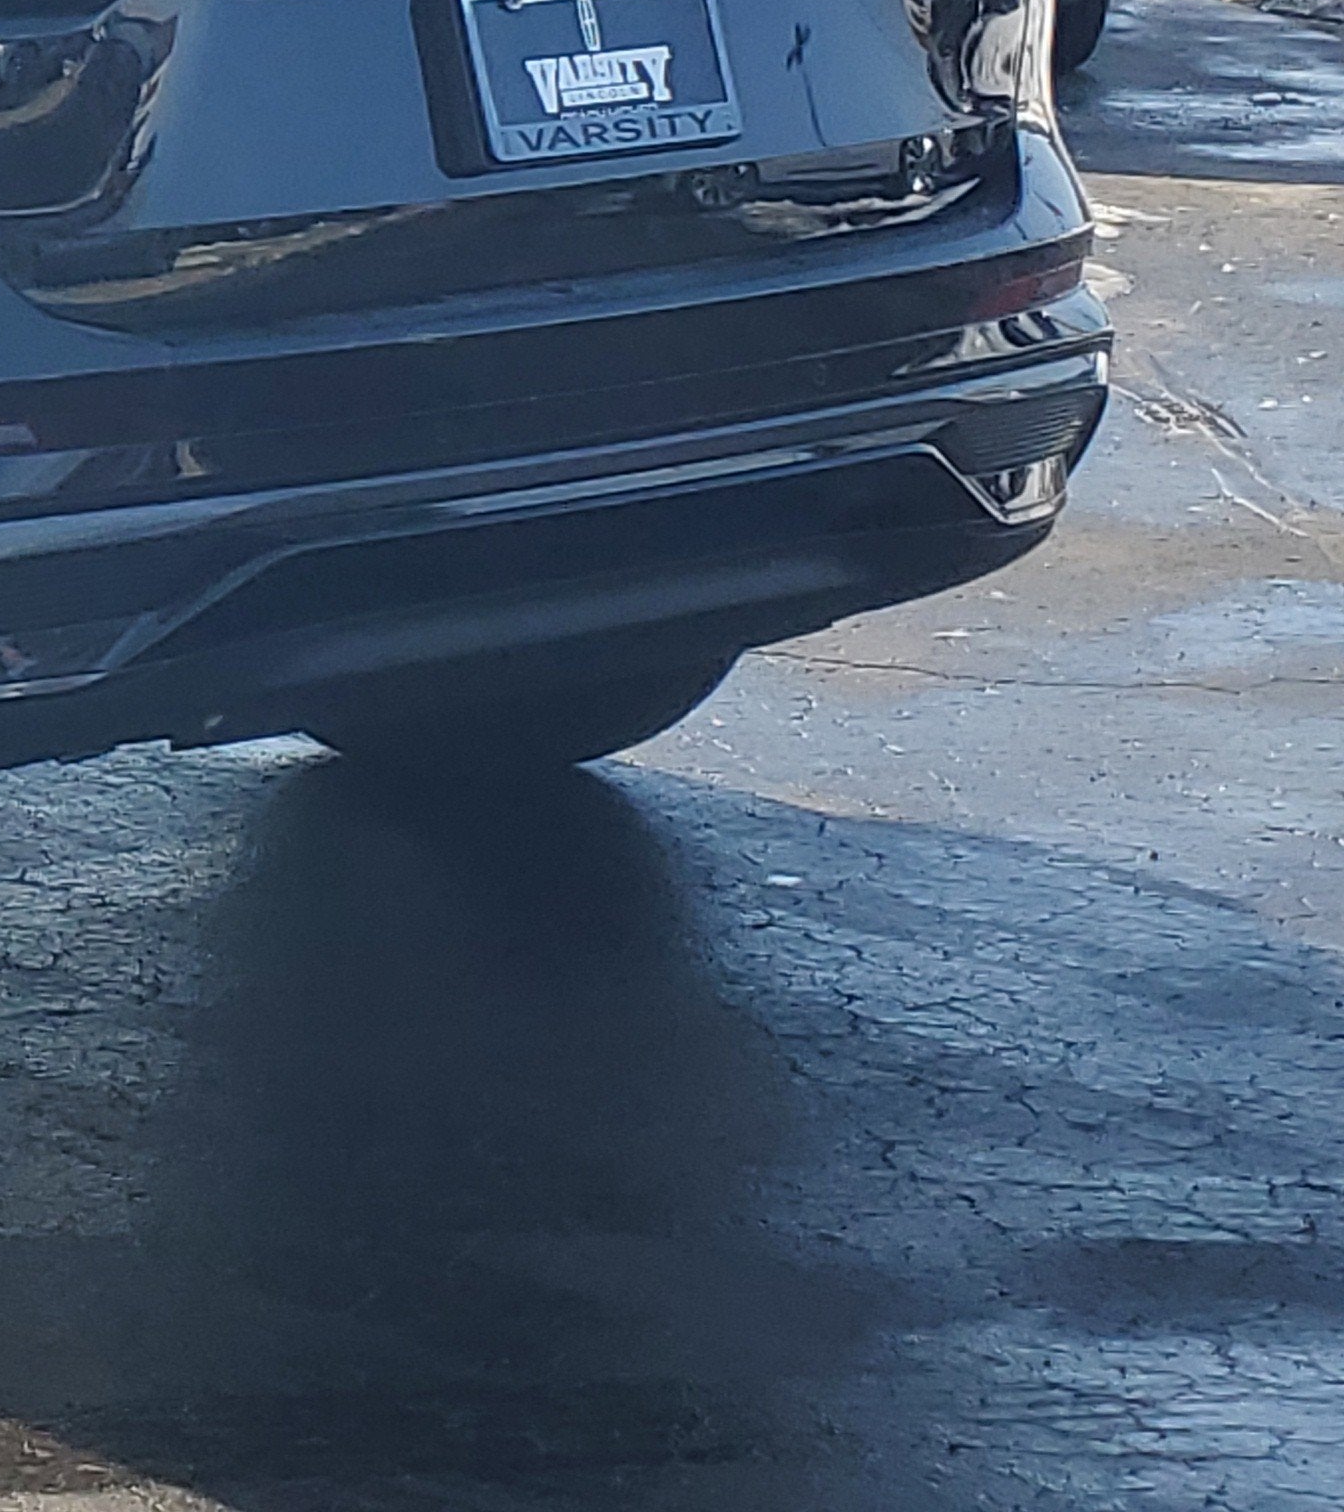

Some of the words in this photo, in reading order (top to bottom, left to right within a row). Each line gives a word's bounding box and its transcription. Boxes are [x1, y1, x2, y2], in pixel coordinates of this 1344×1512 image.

[524, 44, 673, 115] VARSITY
[568, 85, 642, 104] LINCOLN
[516, 110, 714, 152] VARSITY
